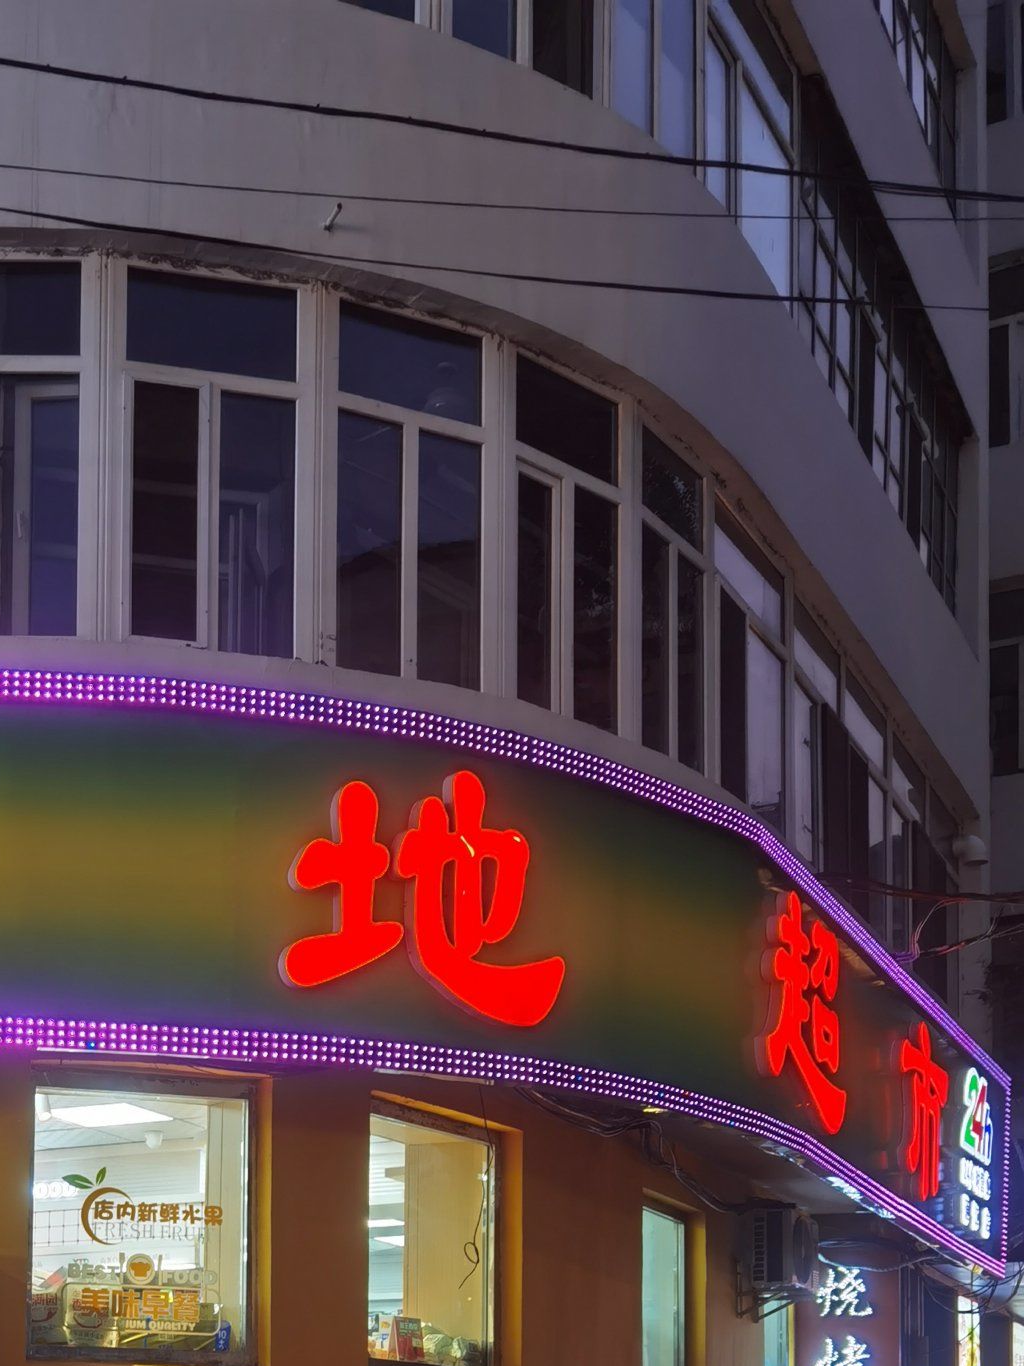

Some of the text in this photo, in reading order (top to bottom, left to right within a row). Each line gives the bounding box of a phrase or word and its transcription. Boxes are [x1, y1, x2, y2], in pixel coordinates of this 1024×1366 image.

[93, 1200, 224, 1226] 店内新鲜水果
[93, 1221, 154, 1240] FRESH
[67, 1262, 218, 1285] BEST FOOD
[80, 1287, 200, 1323] 美味早餐
